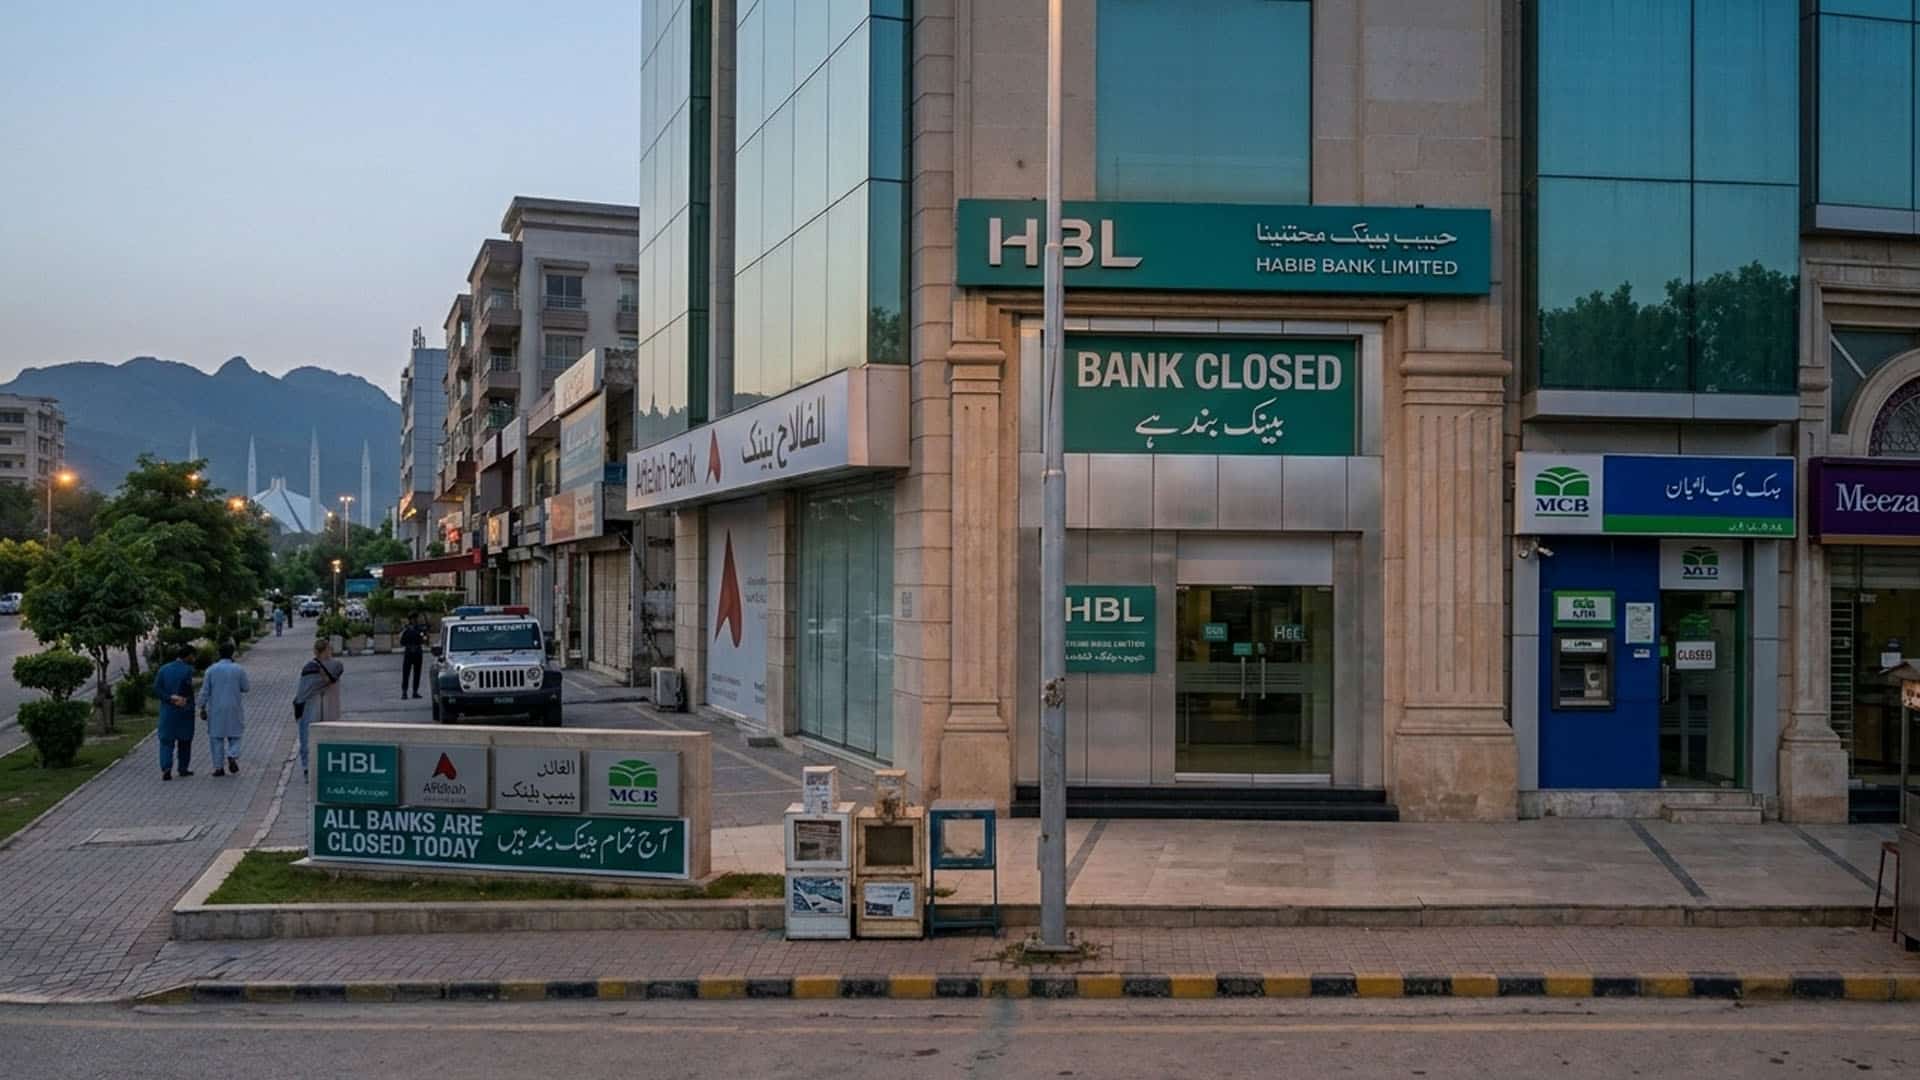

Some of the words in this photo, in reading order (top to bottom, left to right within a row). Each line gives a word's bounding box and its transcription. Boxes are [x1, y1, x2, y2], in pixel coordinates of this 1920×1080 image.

[989, 217, 1143, 269] HBL
[1256, 257, 1316, 273] HABIB
[1322, 258, 1375, 274] BANK
[1381, 260, 1458, 275] LIMITED
[1077, 351, 1185, 389] BANK
[1195, 352, 1343, 391] CLOSED
[1135, 413, 1181, 449] ہے
[1181, 408, 1218, 437] بند
[1536, 498, 1589, 513] MCB
[1835, 482, 1920, 512] Meeza
[1065, 597, 1144, 622] HBL
[327, 751, 387, 774] HBL
[323, 809, 361, 829] ALL
[367, 810, 436, 833] BANKS
[442, 814, 484, 836] ARE
[328, 832, 405, 855] CLOSED
[412, 836, 480, 859] TODAY
[638, 826, 673, 859] آج
